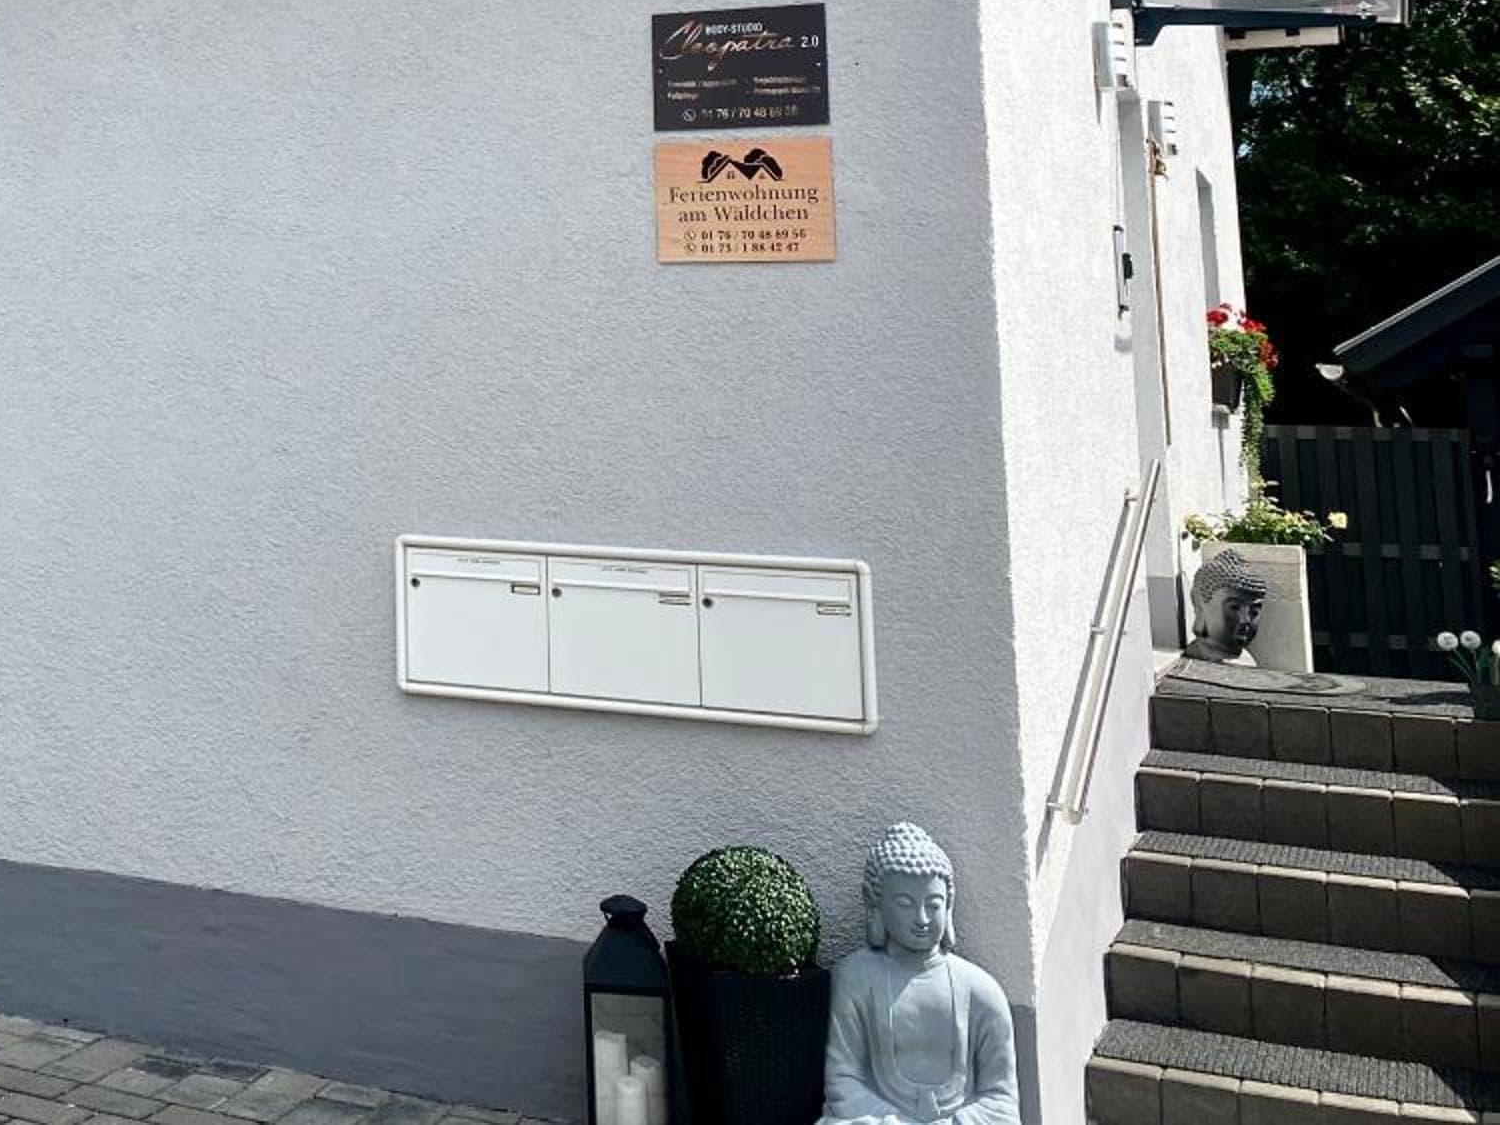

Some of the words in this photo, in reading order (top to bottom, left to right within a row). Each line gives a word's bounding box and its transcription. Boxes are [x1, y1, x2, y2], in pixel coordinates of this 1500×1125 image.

[800, 34, 820, 49] 2.0
[669, 184, 819, 205] Ferienwohnung
[678, 210, 707, 223] am
[714, 203, 809, 223] Wäldchen
[701, 230, 713, 240] 01
